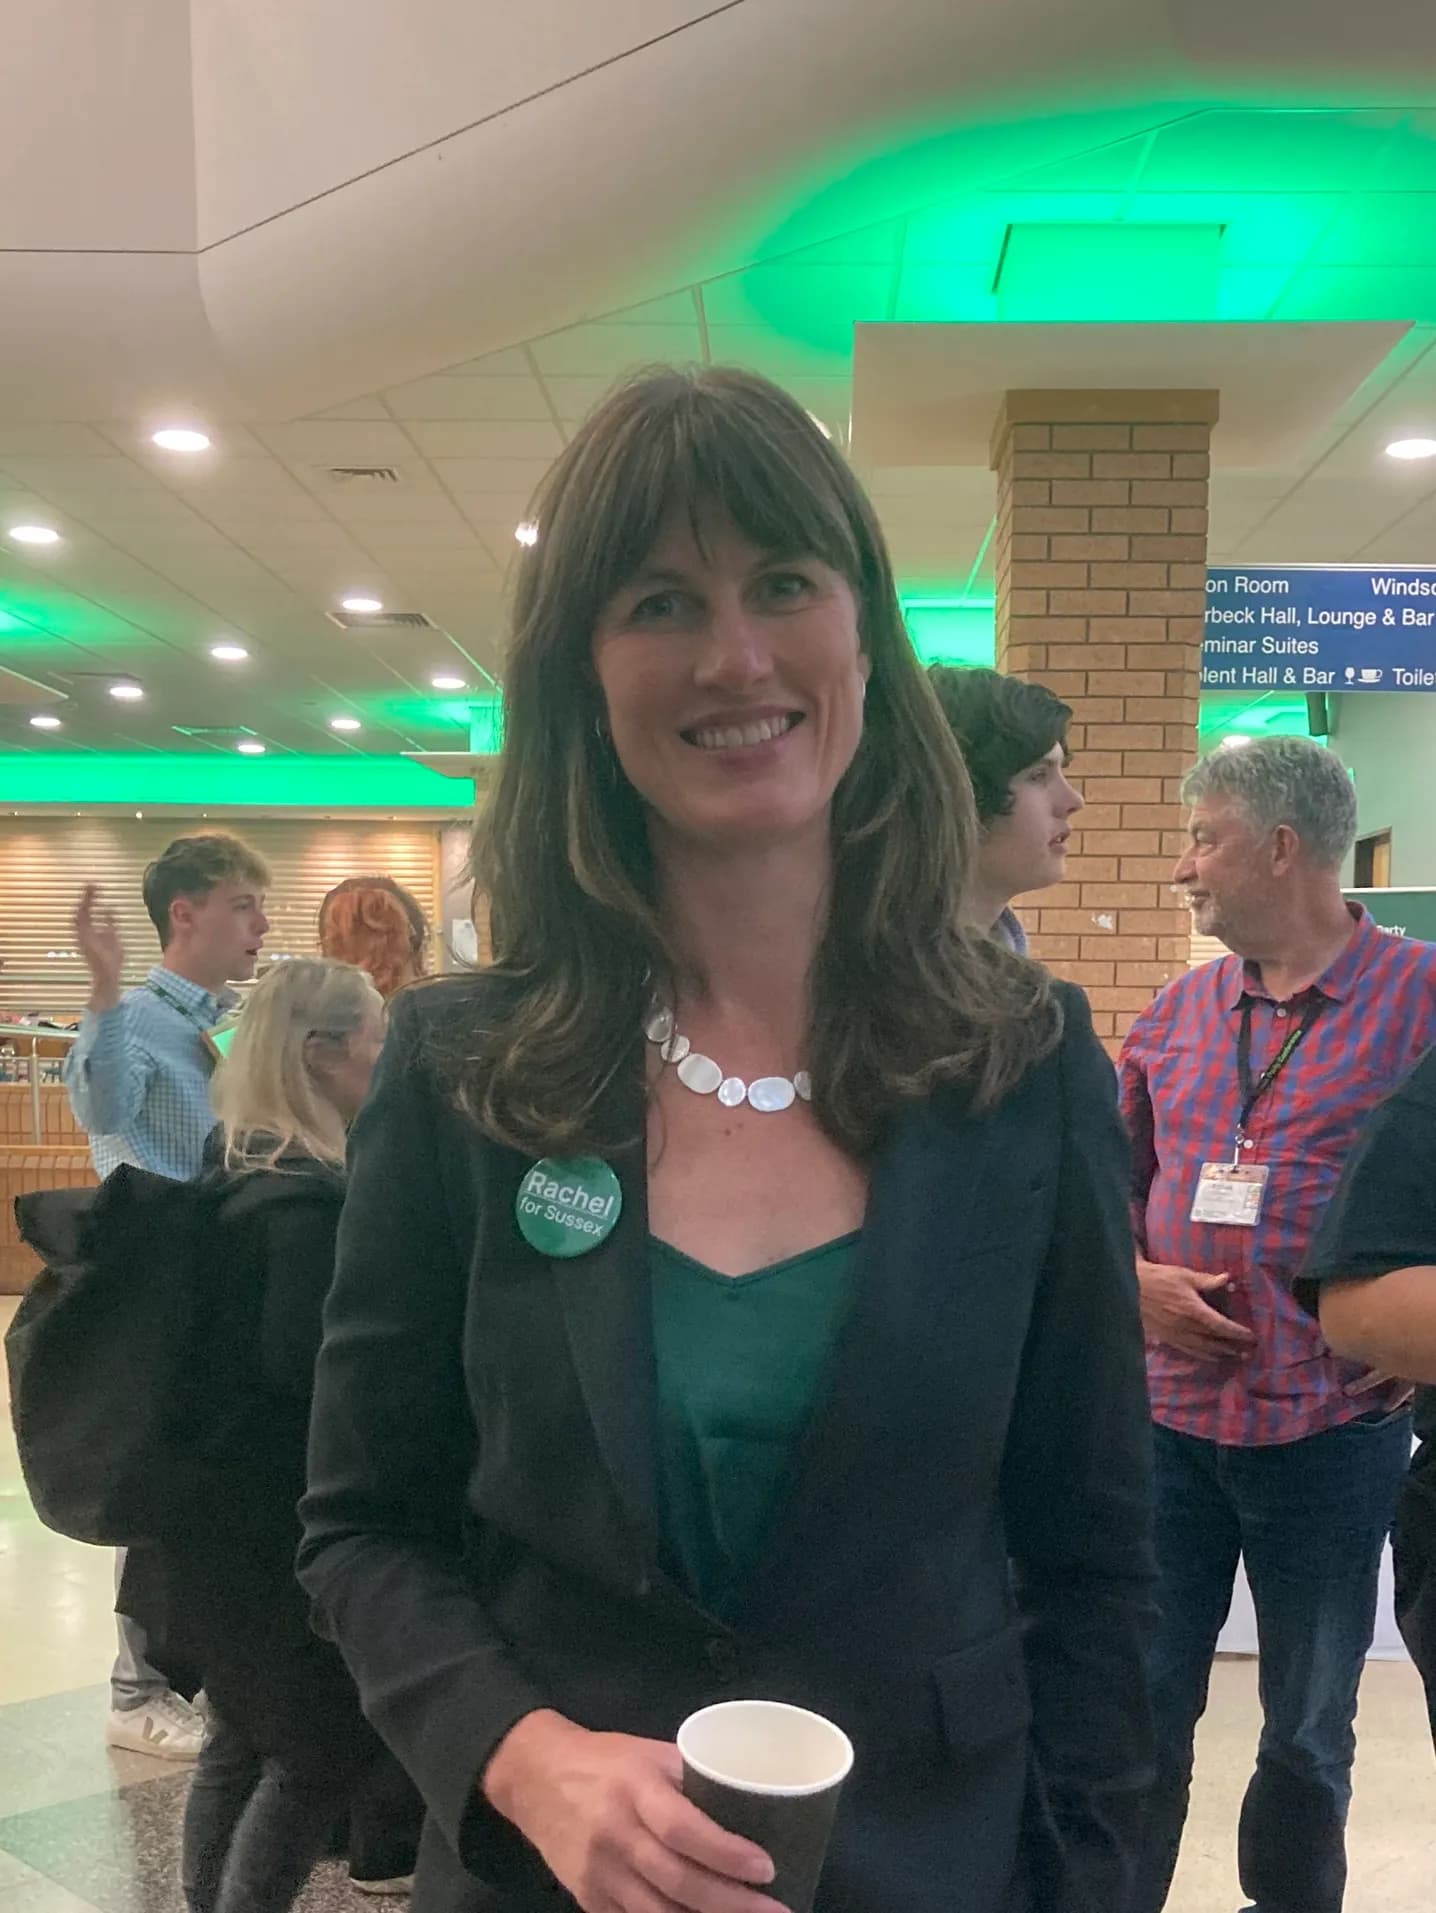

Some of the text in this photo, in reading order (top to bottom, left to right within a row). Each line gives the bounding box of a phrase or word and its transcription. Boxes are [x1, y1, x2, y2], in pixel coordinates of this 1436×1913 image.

[1205, 575, 1290, 594] on Room
[1204, 606, 1435, 630] rbeck Hall, Lounge & Bar
[1200, 636, 1319, 655] minar Suites
[1199, 666, 1336, 685] lent Hall & Bar
[1391, 667, 1436, 686] Toile
[527, 1170, 615, 1217] Rachel
[520, 1196, 604, 1237] for Sussex
